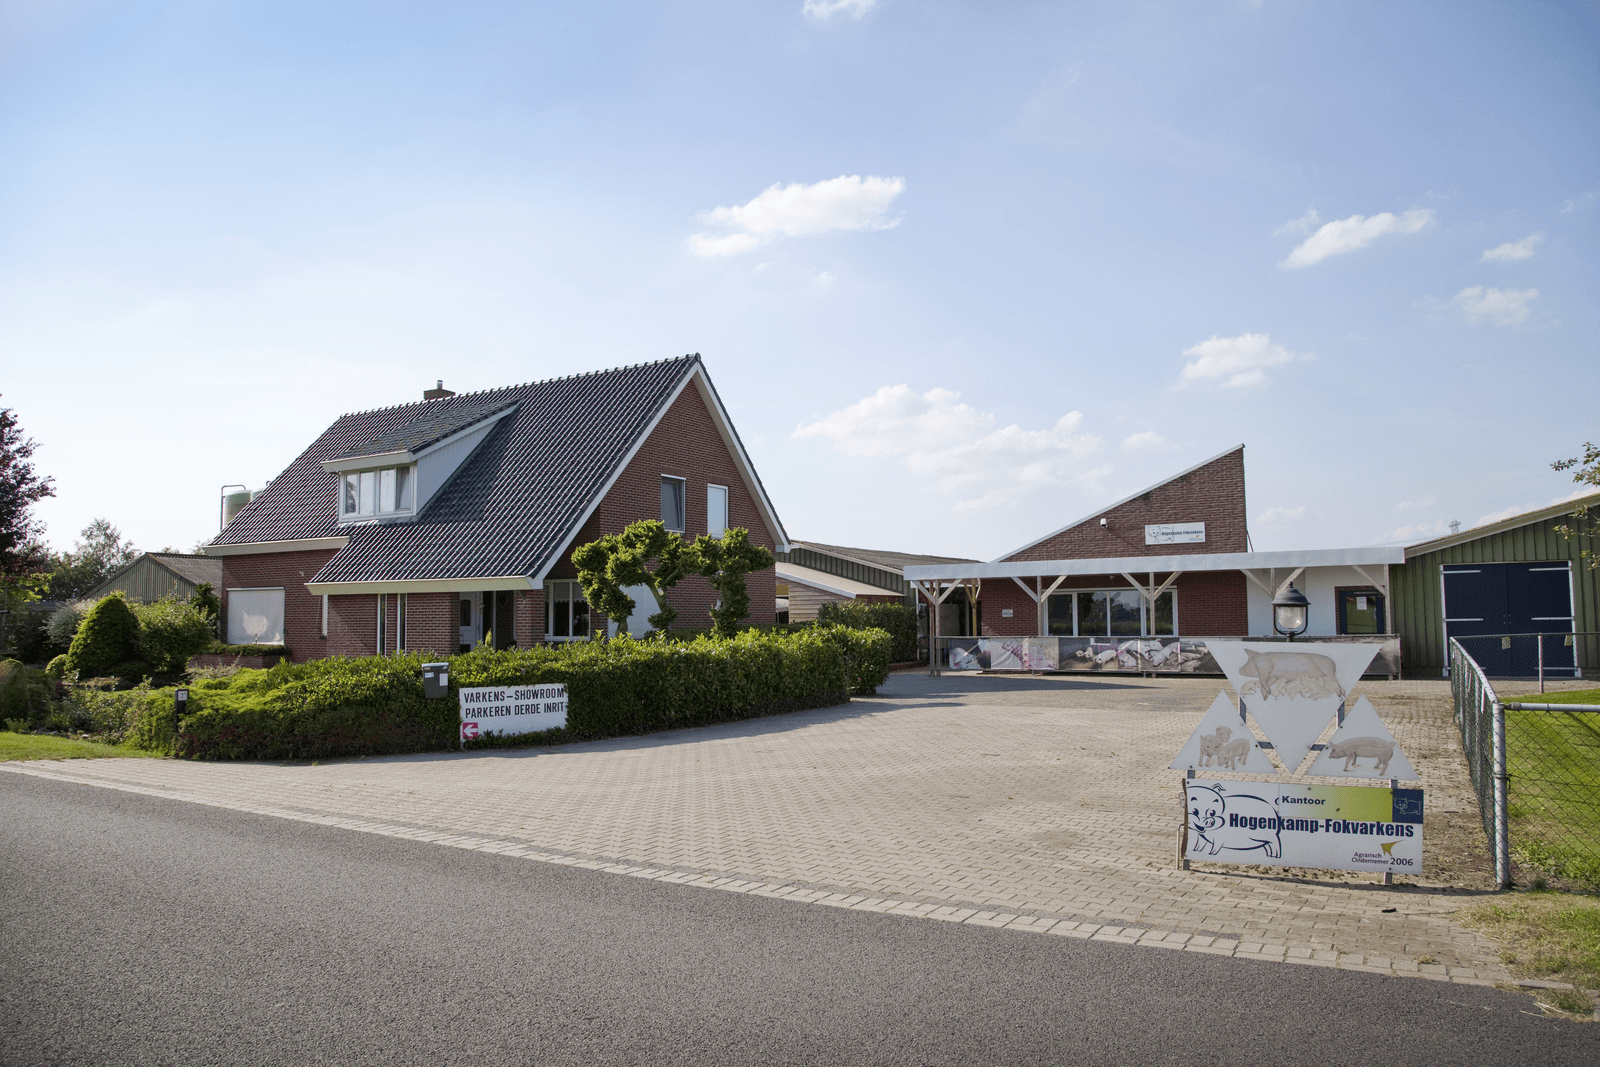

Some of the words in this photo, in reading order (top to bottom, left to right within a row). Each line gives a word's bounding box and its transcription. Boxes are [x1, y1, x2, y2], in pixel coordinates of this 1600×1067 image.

[465, 705, 511, 718] PARKEREN
[514, 703, 541, 715] DERDE
[543, 702, 565, 713] INRIT
[1281, 795, 1326, 806] Kantoor
[1229, 812, 1414, 838] Hogenkamp-Fokvarkens
[1353, 851, 1382, 859] Agrarisch
[1351, 857, 1389, 865] Ondernemer
[1389, 857, 1414, 866] 2006
